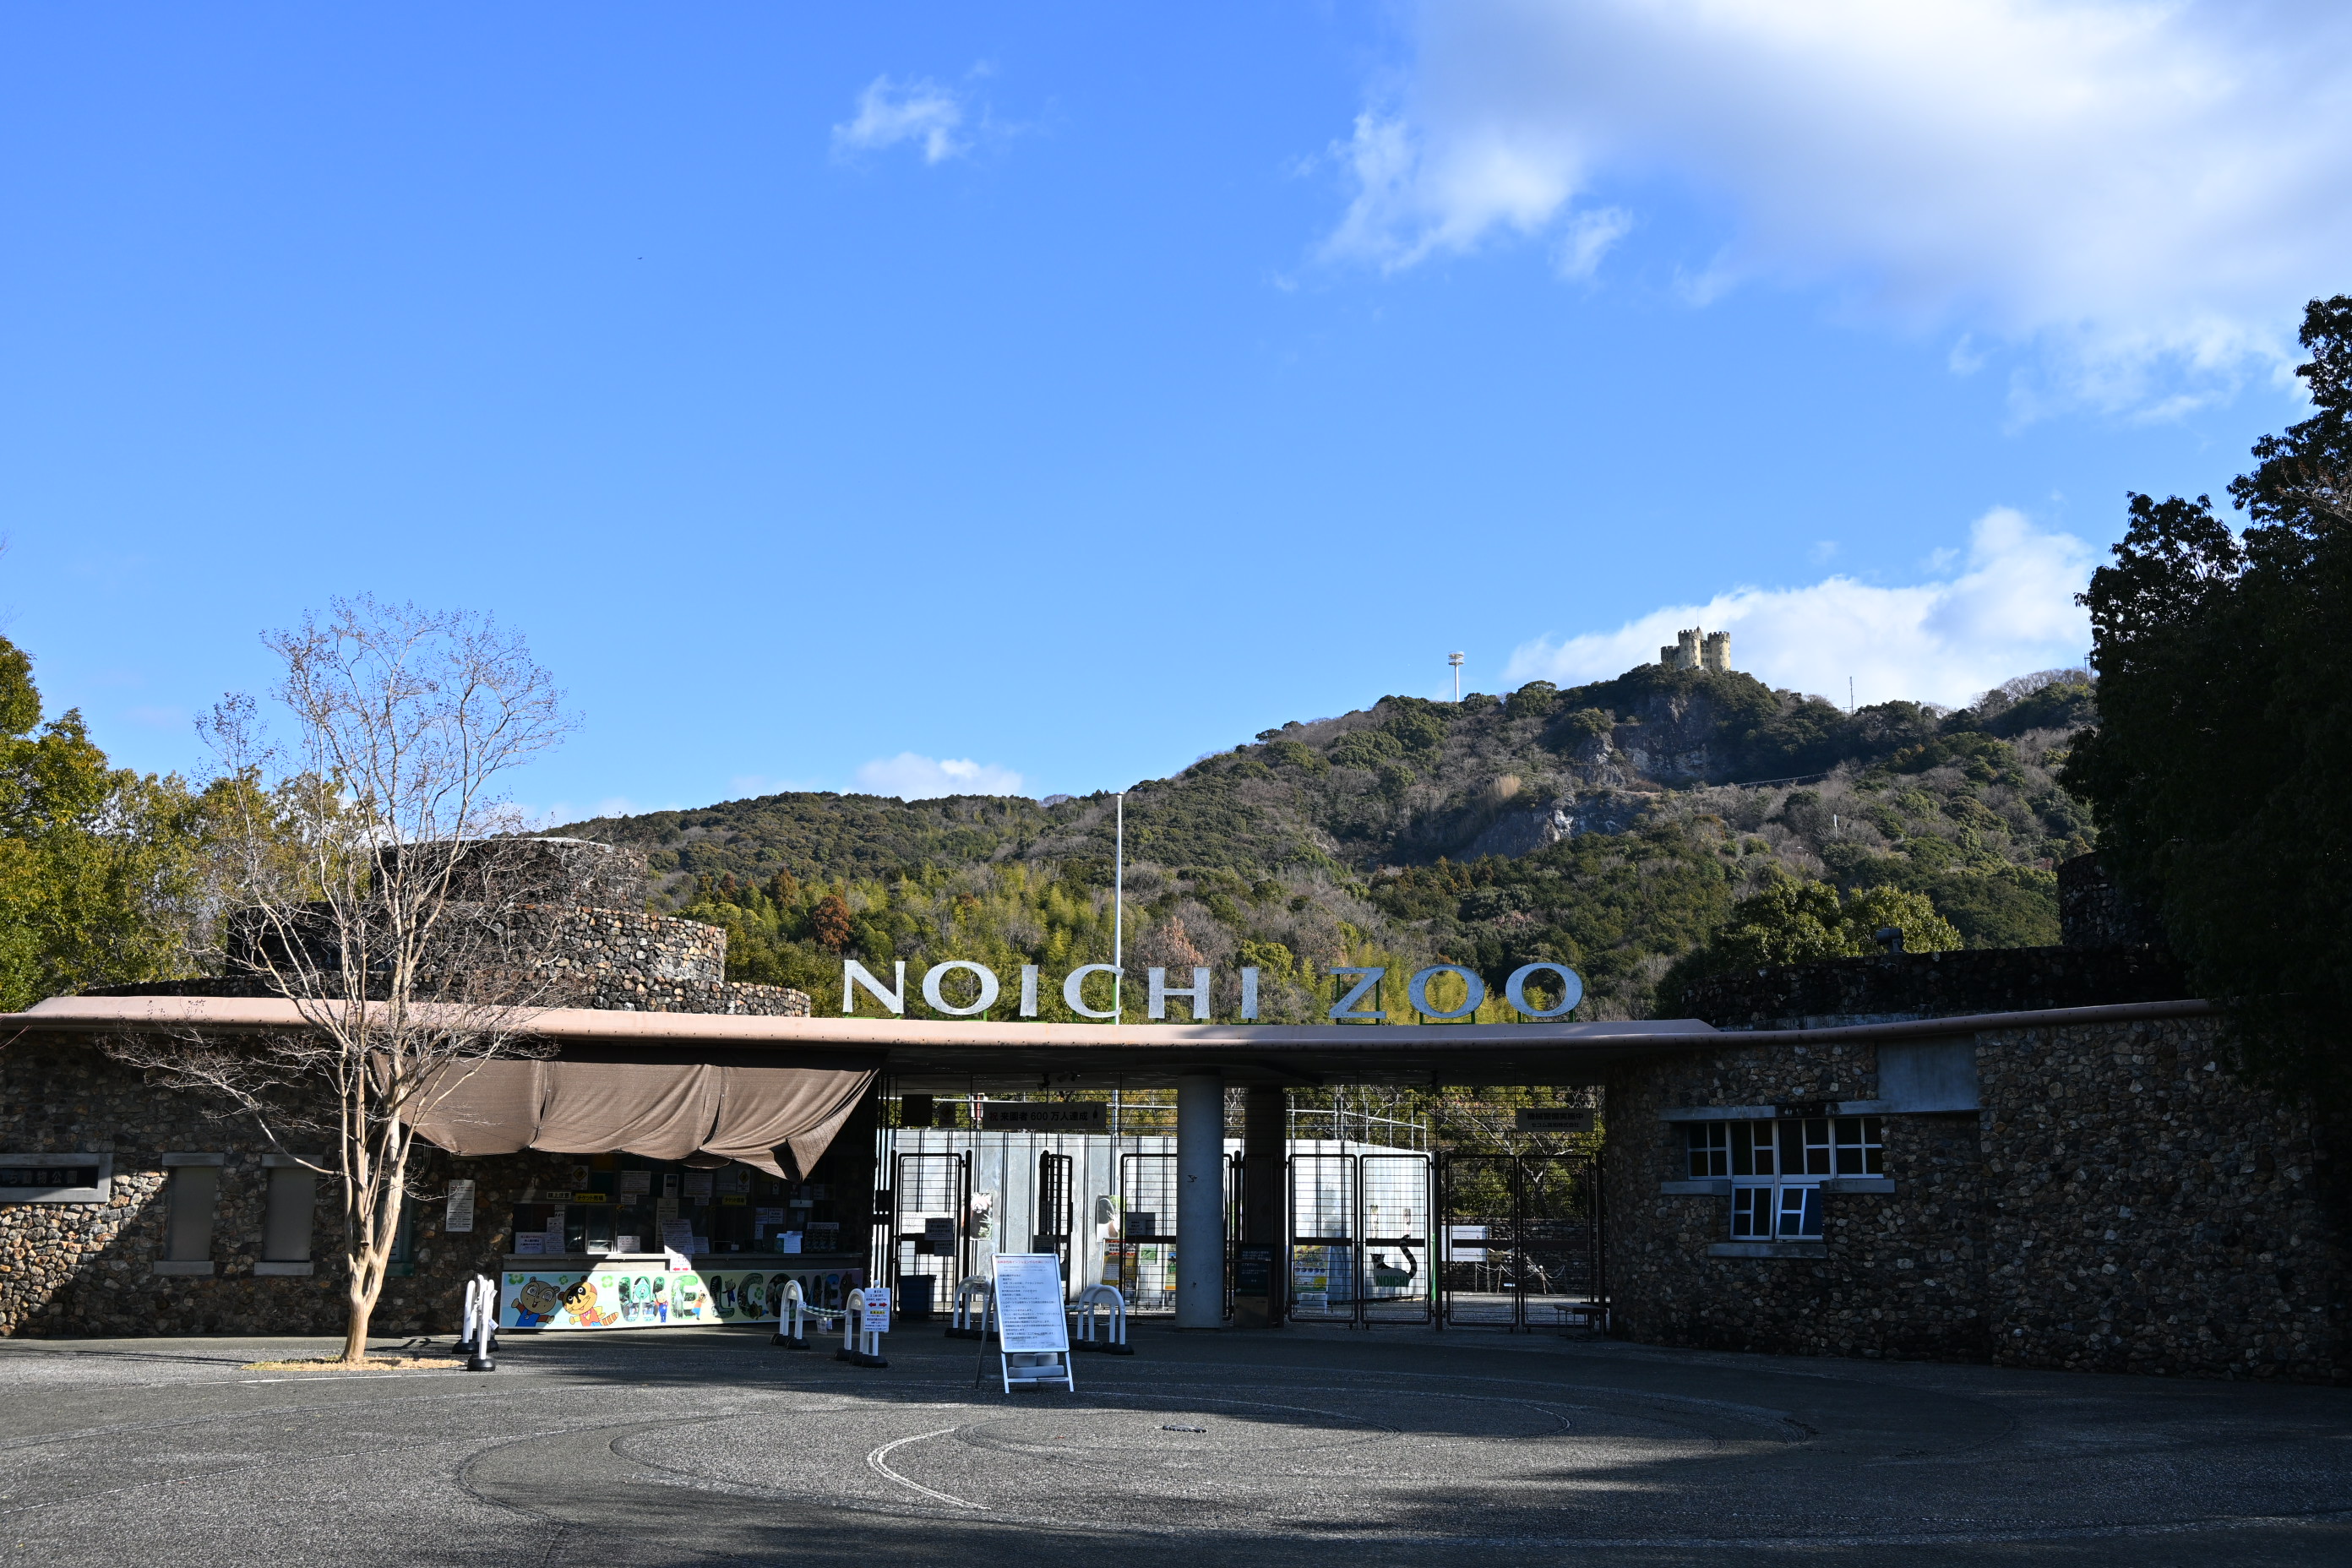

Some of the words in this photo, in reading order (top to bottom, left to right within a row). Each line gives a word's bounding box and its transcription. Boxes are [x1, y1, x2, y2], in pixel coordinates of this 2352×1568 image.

[842, 959, 1259, 1020] NOICHI
[1328, 962, 1583, 1020] ZOO
[988, 1112, 999, 1121] 祝
[1000, 1111, 1028, 1121] 来園者
[1031, 1111, 1048, 1121] 600
[1050, 1111, 1088, 1121] 万人達成
[0, 1169, 78, 1184] ち動物公園
[1375, 1275, 1410, 1288] NOICHI
[618, 1272, 840, 1321] WELCOME
